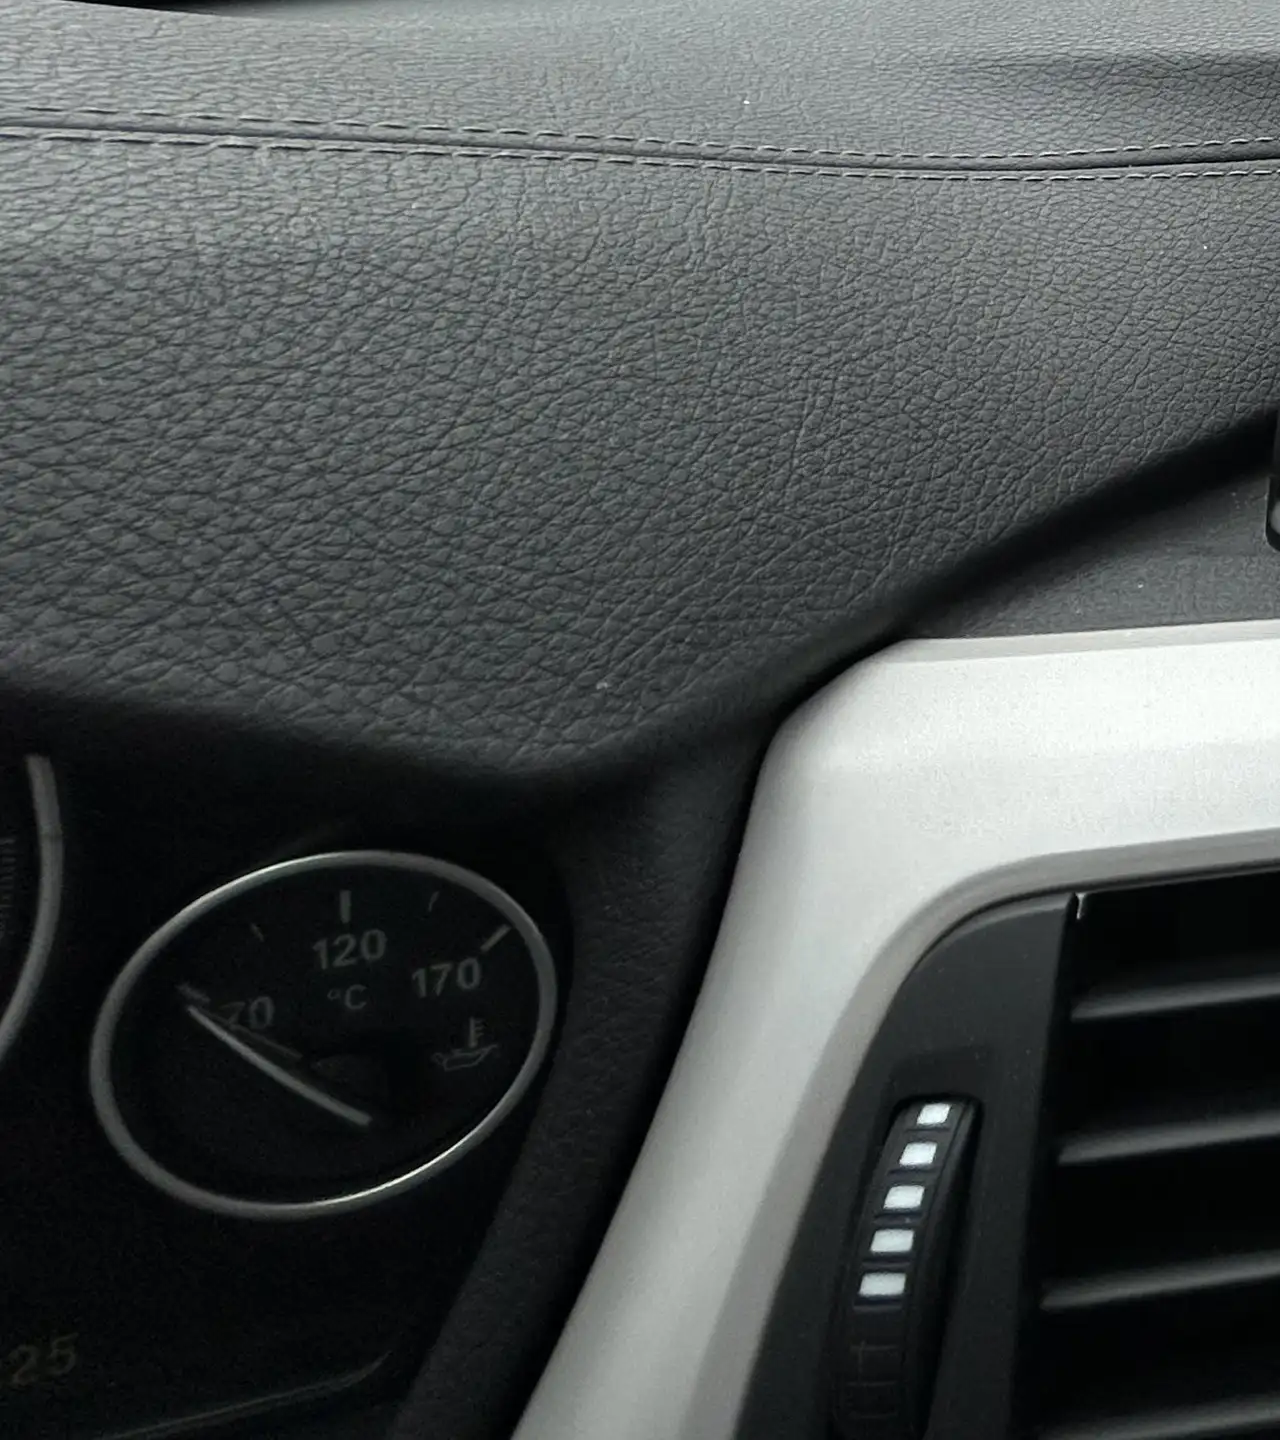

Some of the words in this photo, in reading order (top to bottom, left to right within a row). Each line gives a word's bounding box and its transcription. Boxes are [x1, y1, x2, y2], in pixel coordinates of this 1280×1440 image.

[311, 927, 388, 970] 120
[411, 956, 482, 1000] 170
[222, 995, 275, 1030] 70
